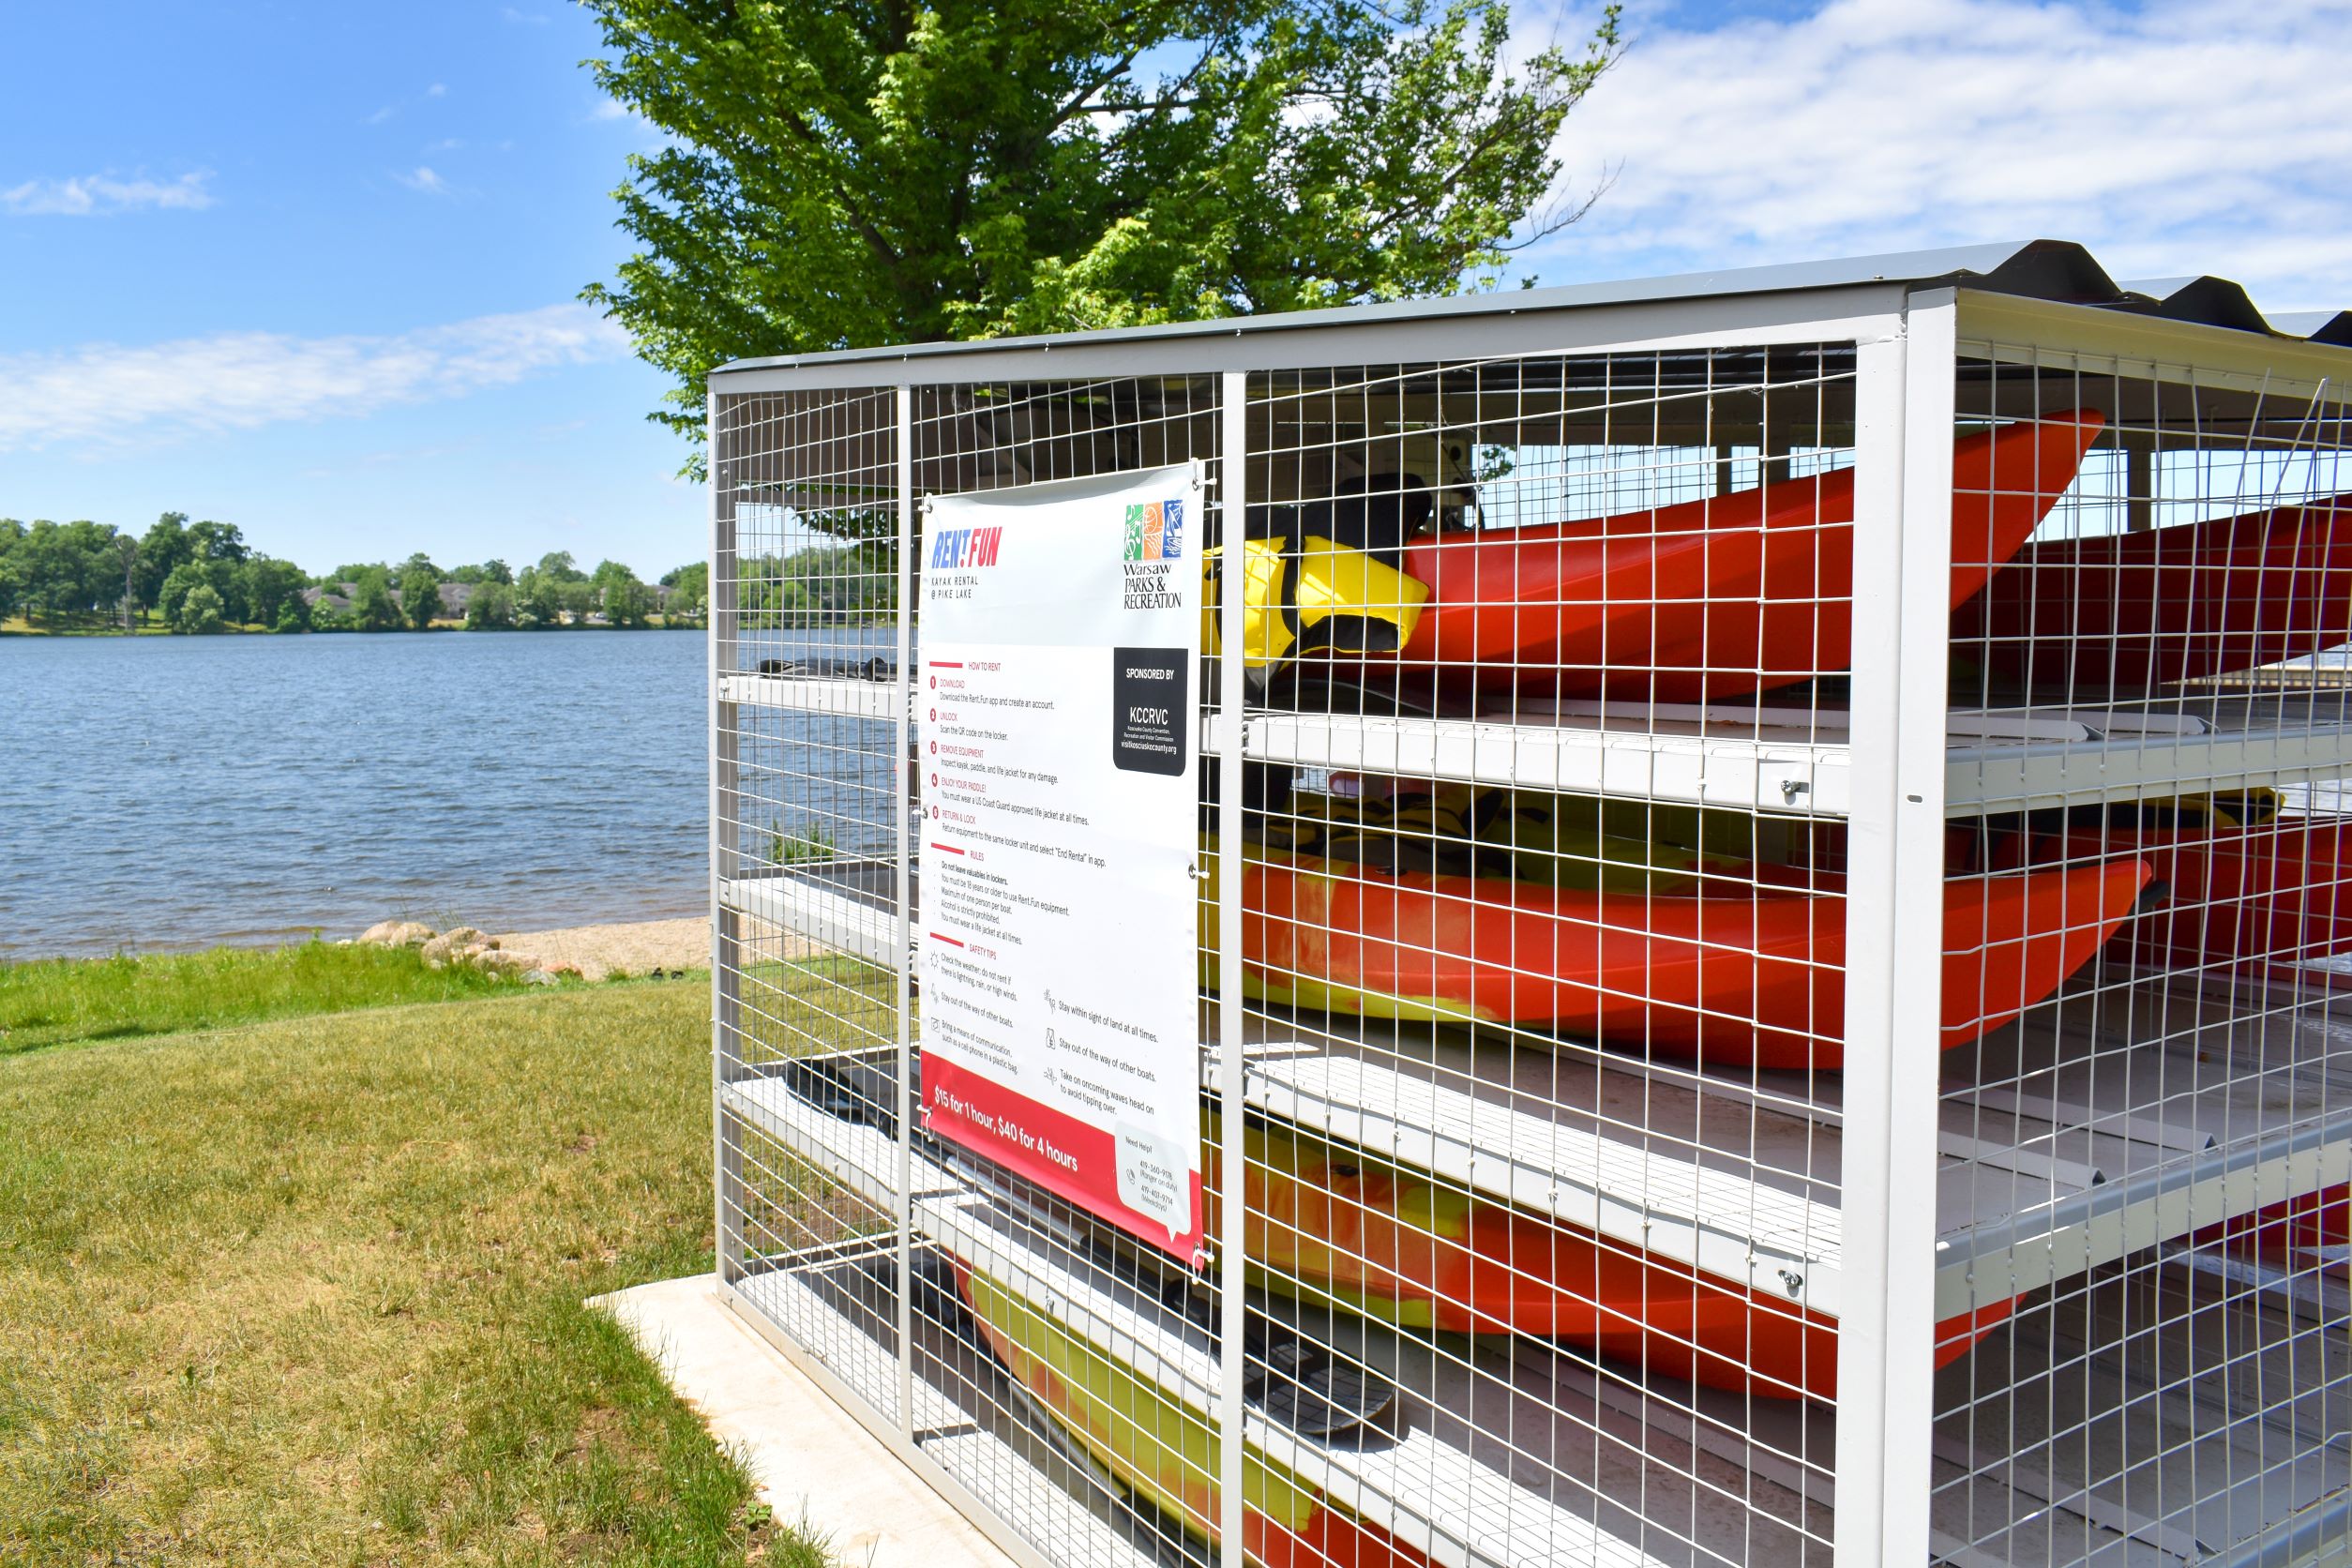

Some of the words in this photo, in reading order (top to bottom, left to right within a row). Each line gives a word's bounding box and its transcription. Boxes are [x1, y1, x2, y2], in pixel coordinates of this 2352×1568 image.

[1123, 564, 1171, 576] Warsaw
[931, 577, 951, 586] KAYAK
[955, 576, 978, 586] RENTAL
[1125, 577, 1154, 593] PARKS
[1157, 576, 1166, 592] &
[931, 589, 935, 600] @
[938, 589, 953, 599] PIKE
[957, 589, 972, 599] LAKE
[1124, 593, 1181, 609] RECREATION
[968, 662, 980, 670] HOW
[988, 663, 1001, 671] RENT
[1126, 668, 1165, 679] SPONSORED
[1166, 669, 1174, 680] BY
[940, 678, 965, 688] DOWNLOAD
[940, 692, 960, 702] Download
[989, 698, 998, 708] app
[999, 697, 1008, 706] and
[1009, 698, 1024, 707] create
[940, 712, 957, 721] UNLOCK
[1130, 707, 1168, 725] KCCRVC
[940, 725, 950, 734] Scan
[966, 728, 977, 737] code
[941, 745, 958, 755] REMOVE
[959, 747, 983, 758] EQUIPMENT
[941, 758, 956, 769] Inspect
[987, 766, 996, 775] and
[1004, 767, 1019, 778] jacket
[1028, 772, 1036, 783] any
[942, 777, 955, 788] ENJOY
[956, 780, 967, 789] YOUR
[968, 781, 986, 792] PADDLE!
[950, 793, 960, 802] must
[982, 798, 995, 808] Coast
[996, 800, 1010, 811] Guard
[1011, 805, 1034, 816] approved
[1043, 809, 1058, 820] jacket
[942, 810, 959, 821] RETURN
[964, 814, 976, 824] LOCK
[942, 822, 956, 834] Return
[956, 827, 978, 839] equipment
[992, 835, 1004, 845] same
[1005, 836, 1018, 848] locker
[1019, 840, 1028, 850] unit
[1030, 843, 1039, 852] and
[1040, 844, 1054, 856] select
[971, 849, 984, 861] RULES
[956, 864, 966, 875] leave
[967, 868, 985, 880] valuables
[941, 886, 960, 900] Maximum
[975, 898, 991, 909] person
[950, 877, 960, 886] must
[972, 883, 983, 893] years
[990, 886, 1002, 898] older
[1009, 893, 1017, 902] use
[941, 898, 956, 911] Alcohol
[961, 905, 975, 919] strictly
[949, 916, 959, 926] must
[960, 919, 970, 929] wear
[982, 923, 995, 937] jacket
[969, 944, 986, 957] SAFETY
[986, 950, 996, 960] TIPS
[1059, 1000, 1070, 1015] Stay
[1071, 1006, 1087, 1019] within
[1089, 1012, 1101, 1024] sight
[1103, 1016, 1109, 1026] of
[1110, 1018, 1123, 1031] land
[1124, 1023, 1130, 1033] at
[1060, 1037, 1070, 1053] Stay
[1072, 1045, 1081, 1054] out
[1082, 1047, 1088, 1057] of
[1089, 1049, 1099, 1061] the
[1100, 1054, 1111, 1068] way
[1112, 1058, 1118, 1068] of
[1120, 1060, 1135, 1075] other
[1060, 1069, 1072, 1082] Take
[1074, 1076, 1081, 1086] on
[1082, 1079, 1109, 1099] oncoming
[1110, 1090, 1128, 1105] waves
[1129, 1096, 1144, 1111] head
[1146, 1103, 1154, 1115] on
[1060, 1084, 1066, 1095] to
[1068, 1090, 1082, 1101] avoid
[1083, 1093, 1102, 1111] tipping
[935, 1085, 949, 1108] $15
[950, 1094, 963, 1114] for
[965, 1102, 969, 1118] 1
[971, 1103, 996, 1135] hour,
[998, 1115, 1017, 1142] $40
[1019, 1128, 1035, 1151] for
[1037, 1137, 1044, 1156] 4
[1046, 1140, 1078, 1173] hours
[1126, 1136, 1138, 1147] Need
